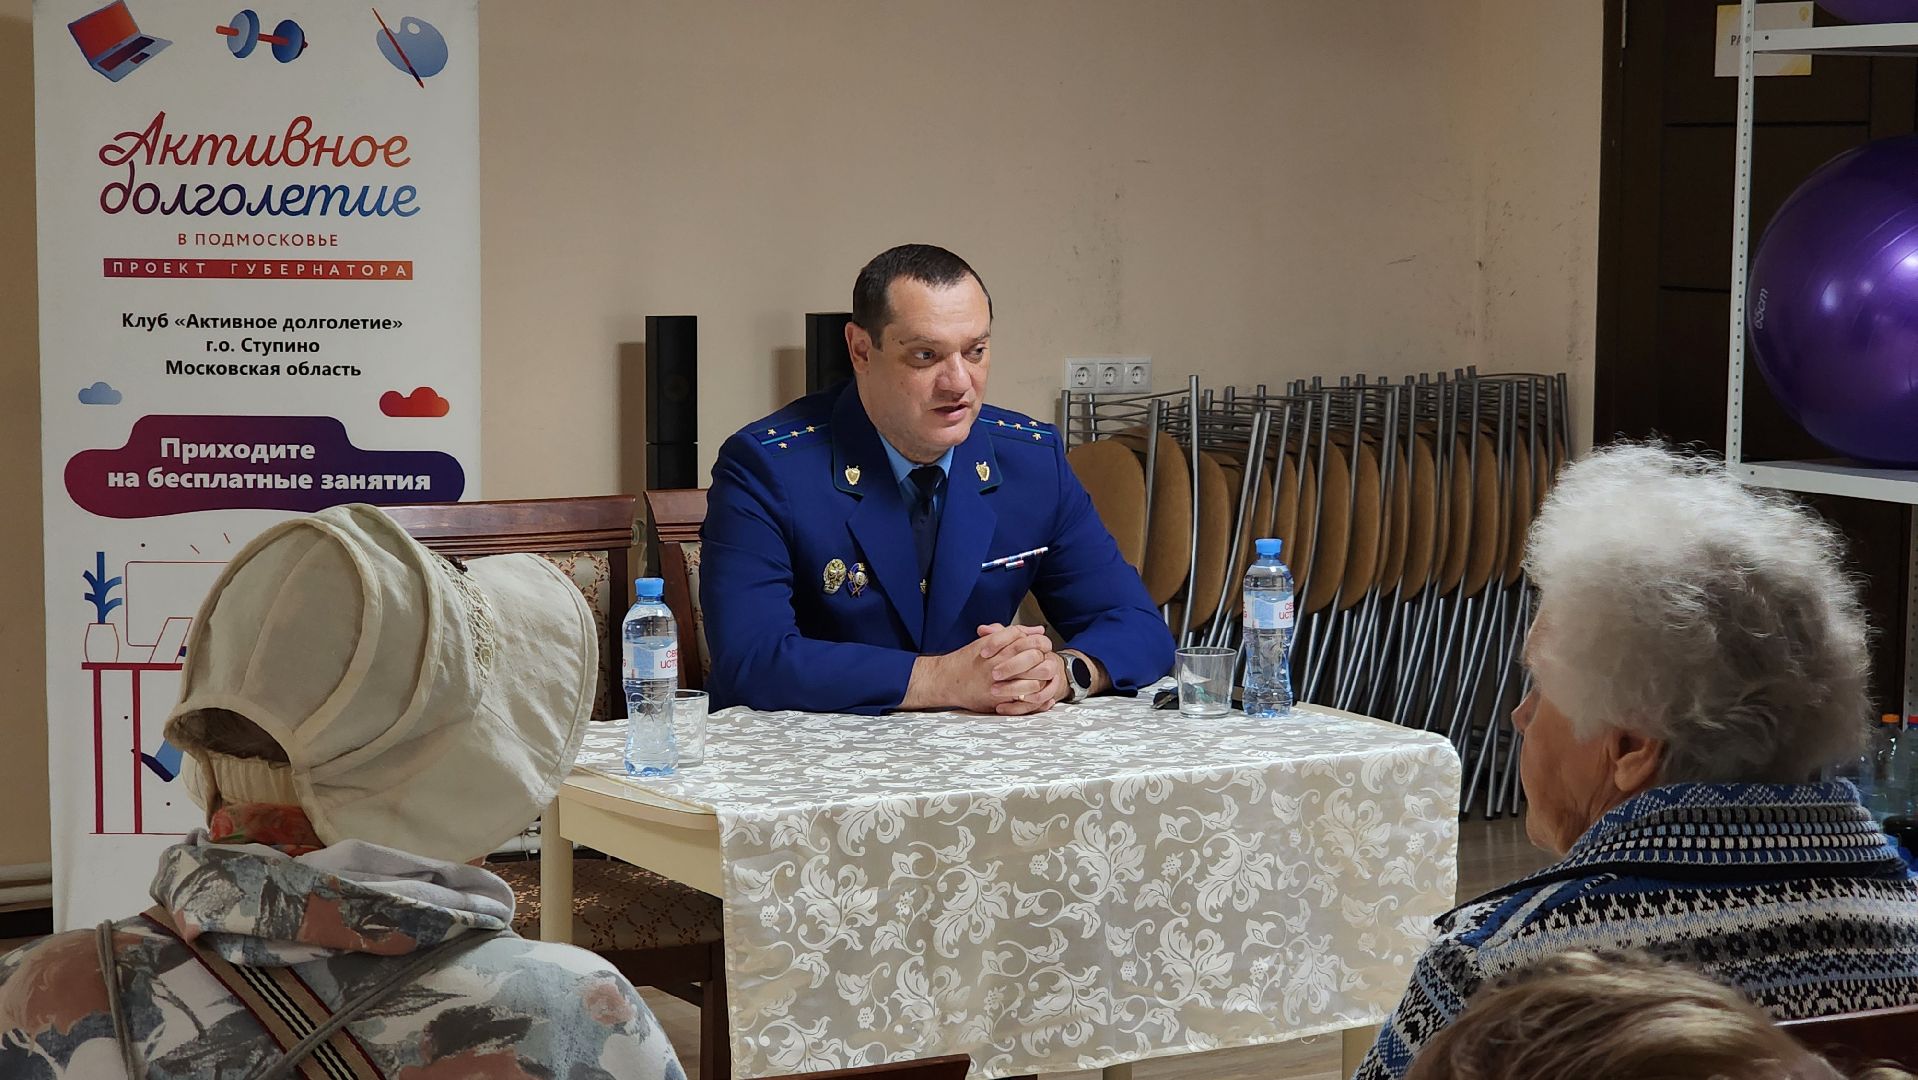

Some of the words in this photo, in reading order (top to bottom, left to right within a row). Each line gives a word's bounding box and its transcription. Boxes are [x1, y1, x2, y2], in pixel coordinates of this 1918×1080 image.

[98, 111, 411, 168] Активное
[100, 158, 420, 217] долголетие
[179, 234, 186, 245] В
[196, 234, 337, 247] ПОДМОСКОВЬЕ
[113, 261, 206, 274] ПРОЕКТ
[231, 263, 407, 277] ГУБЕРНАТОРА
[123, 313, 168, 331] Клуб
[175, 314, 277, 328] «Активное
[283, 318, 402, 332] долголетие»
[207, 341, 234, 352] г.о.
[241, 338, 319, 356] Ступино
[166, 360, 280, 375] Московская
[287, 361, 361, 376] область
[160, 437, 316, 462] Приходите
[109, 473, 139, 487] на
[148, 467, 312, 489] бесплатные
[321, 475, 430, 490] занятия
